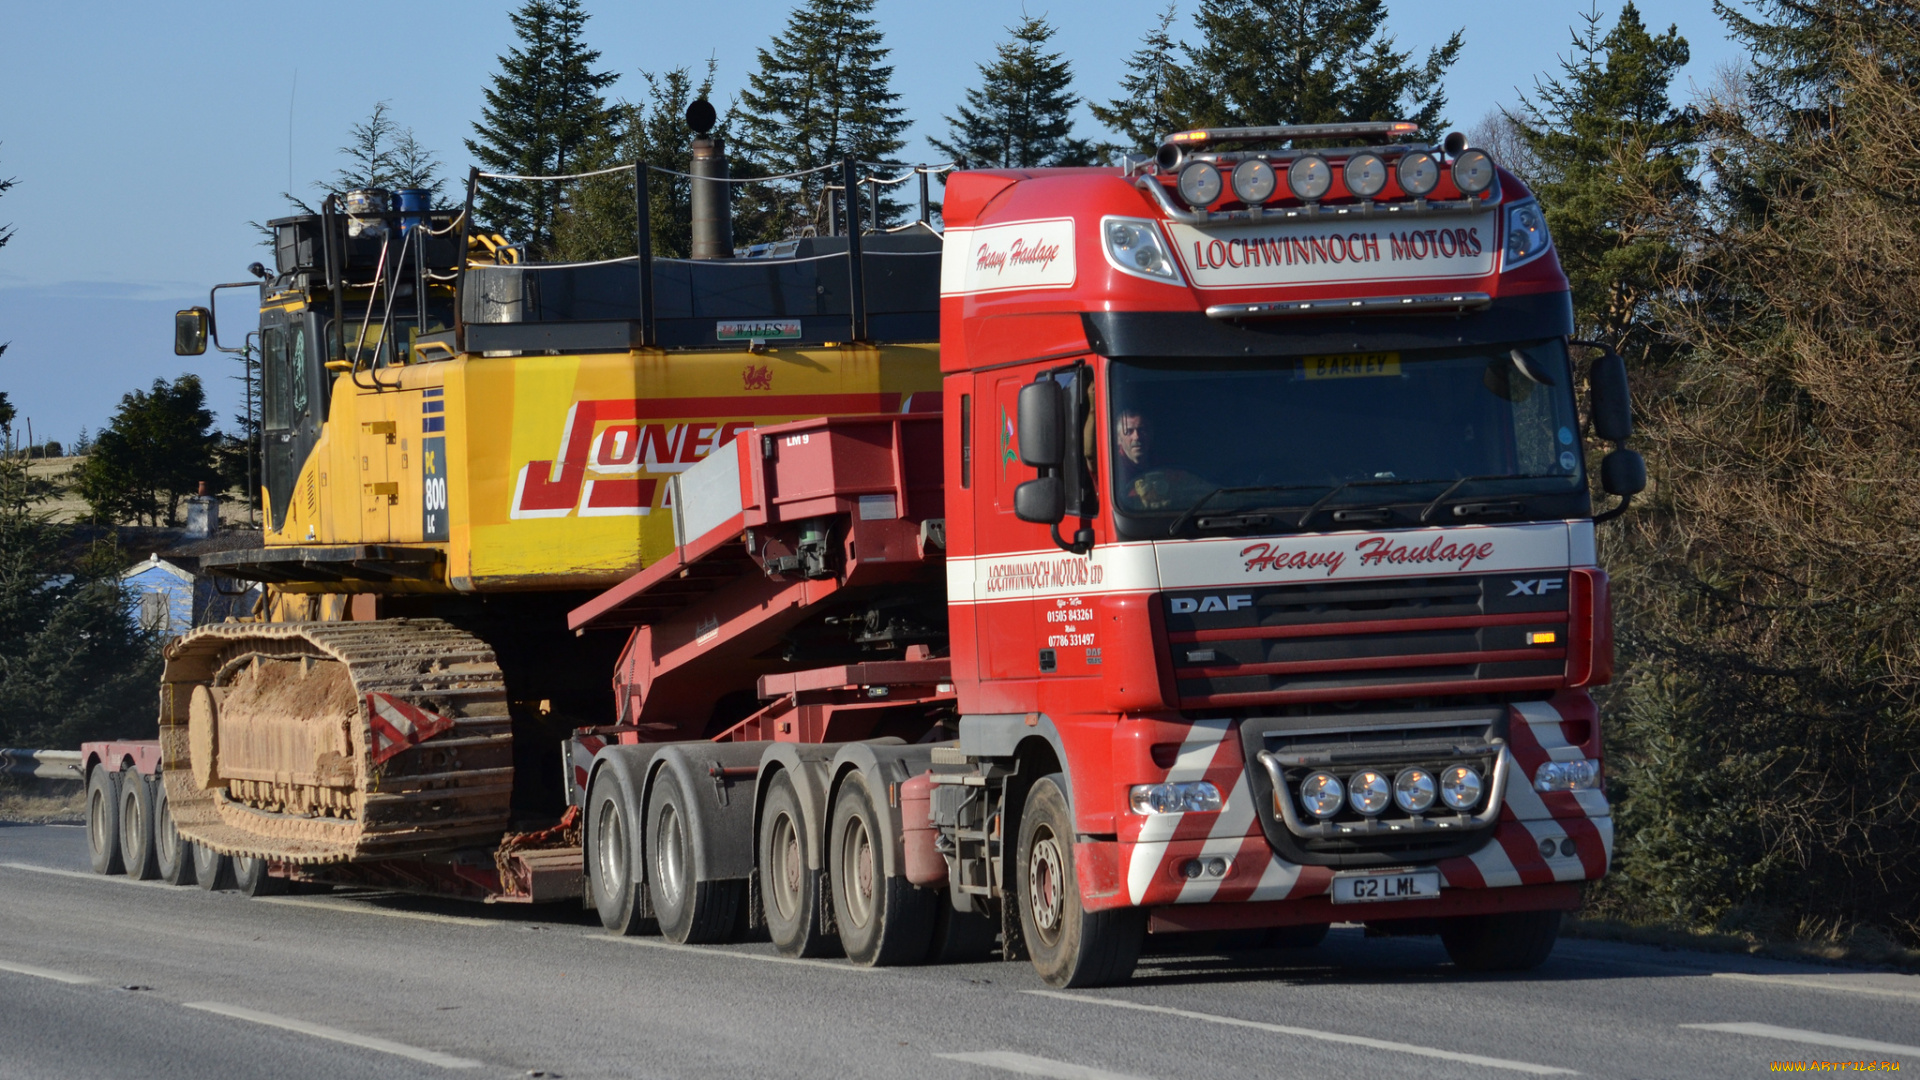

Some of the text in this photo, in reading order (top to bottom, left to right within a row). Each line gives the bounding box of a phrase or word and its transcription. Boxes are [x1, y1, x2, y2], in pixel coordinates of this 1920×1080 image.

[976, 237, 1060, 276] Heavy Haulage
[1193, 227, 1482, 270] LOCHWINNOCH MOTORS
[736, 323, 783, 337] WALES
[1316, 354, 1388, 377] BARNEY
[786, 434, 810, 447] LM 9
[425, 450, 436, 475] PC
[425, 477, 446, 511] 800
[427, 513, 436, 534] LC
[1240, 535, 1495, 577] Heavy Haulage
[987, 557, 1104, 593] LOCHWINNOCH MOTORS LTD
[1505, 578, 1563, 597] XF
[1170, 594, 1252, 614] DAF
[1046, 608, 1093, 623] 01505 843261
[1048, 633, 1095, 647] 07786 331497
[1085, 647, 1102, 656] DAF
[1353, 877, 1421, 898] G2 LML
